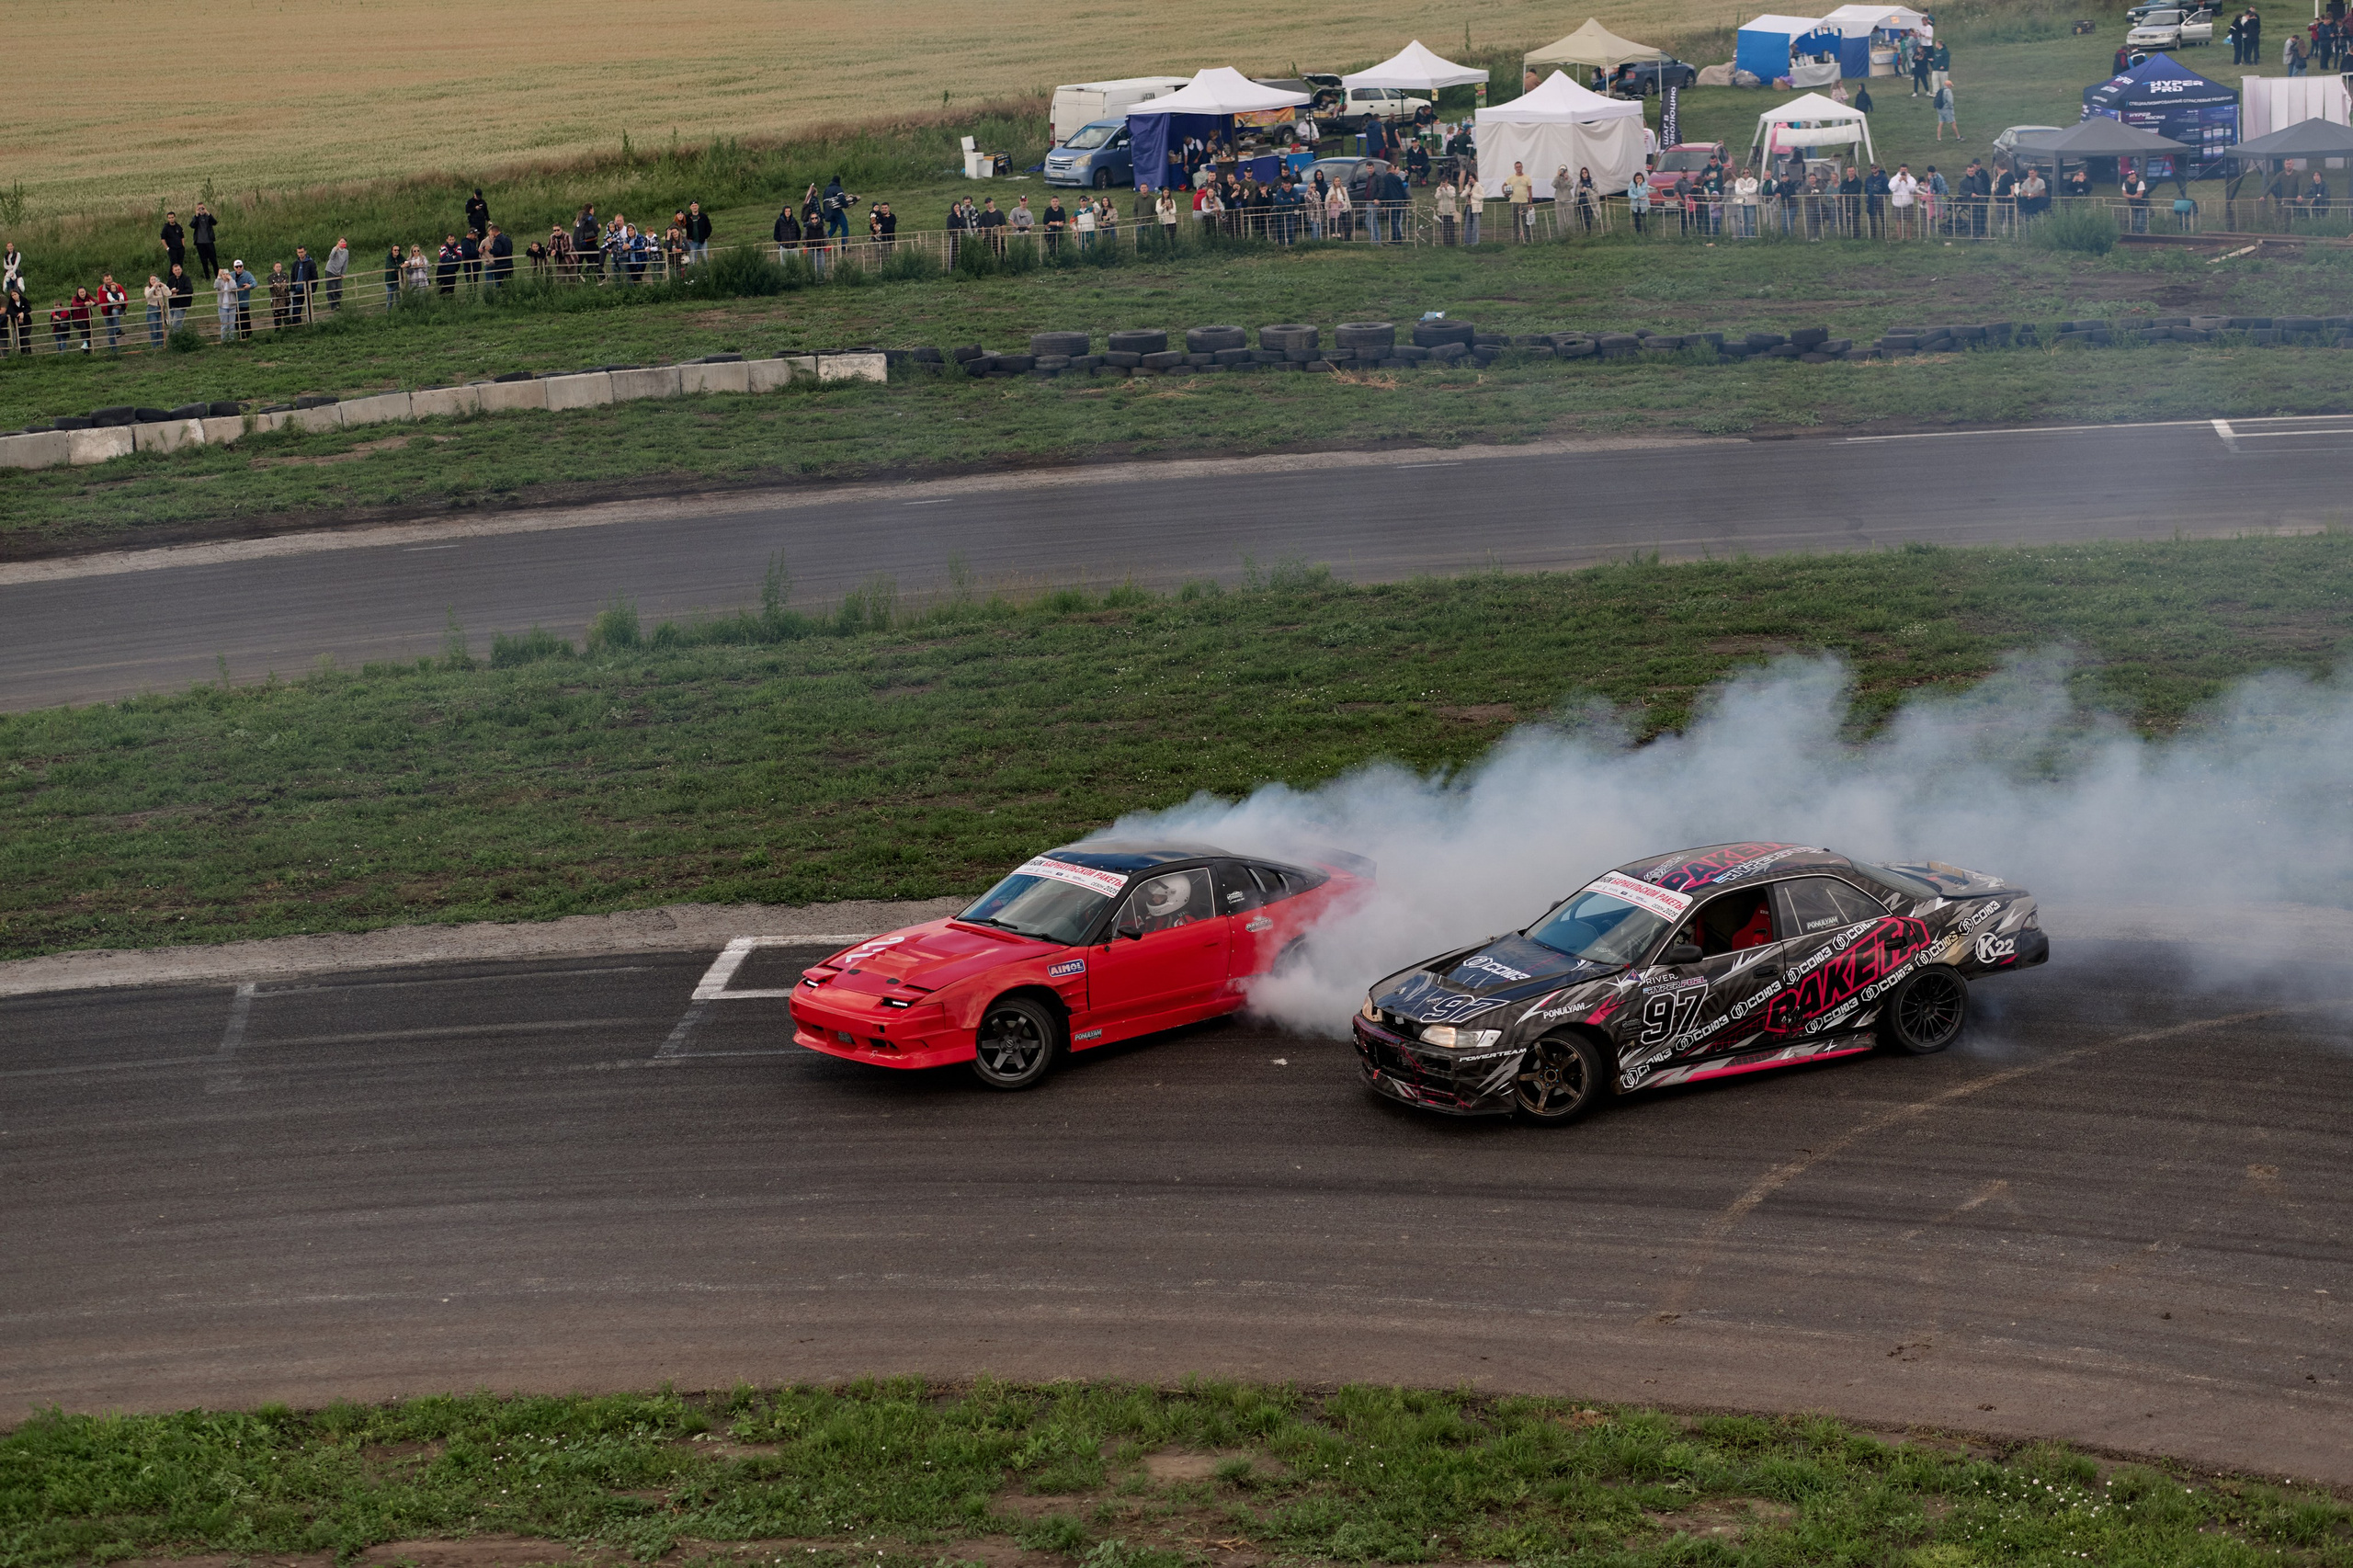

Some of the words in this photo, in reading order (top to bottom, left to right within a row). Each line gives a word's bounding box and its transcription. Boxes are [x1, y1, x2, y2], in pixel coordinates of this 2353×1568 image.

[1041, 860, 1097, 877] БАРНАУЛЬСКОЙ
[1103, 885, 1120, 895] 2025
[1609, 878, 1661, 898] БАРНАУЛЬСКОЙ
[1656, 892, 1688, 911] РАКЕТЫ
[1663, 907, 1679, 918] 2025
[1976, 932, 2015, 964] K22
[1051, 962, 1084, 975] AIMOL
[1482, 961, 1532, 982] СОЮЗ
[1823, 997, 1859, 1025] СОЮЗ
[1879, 962, 1915, 991] СОЮЗ
[1929, 930, 1961, 958] СОЮЗ
[1972, 900, 2001, 926] СОЮЗ
[1645, 973, 1679, 985] RIVER
[1694, 1014, 1730, 1040] СОЮЗ
[1746, 981, 1782, 1009] СОЮЗ
[1799, 948, 1834, 975] СОЮЗ
[1419, 994, 1512, 1024] 97
[1542, 1002, 1586, 1020] PONULYAM
[1641, 983, 1709, 1045] 97
[1074, 1029, 1103, 1041] PONULYAM
